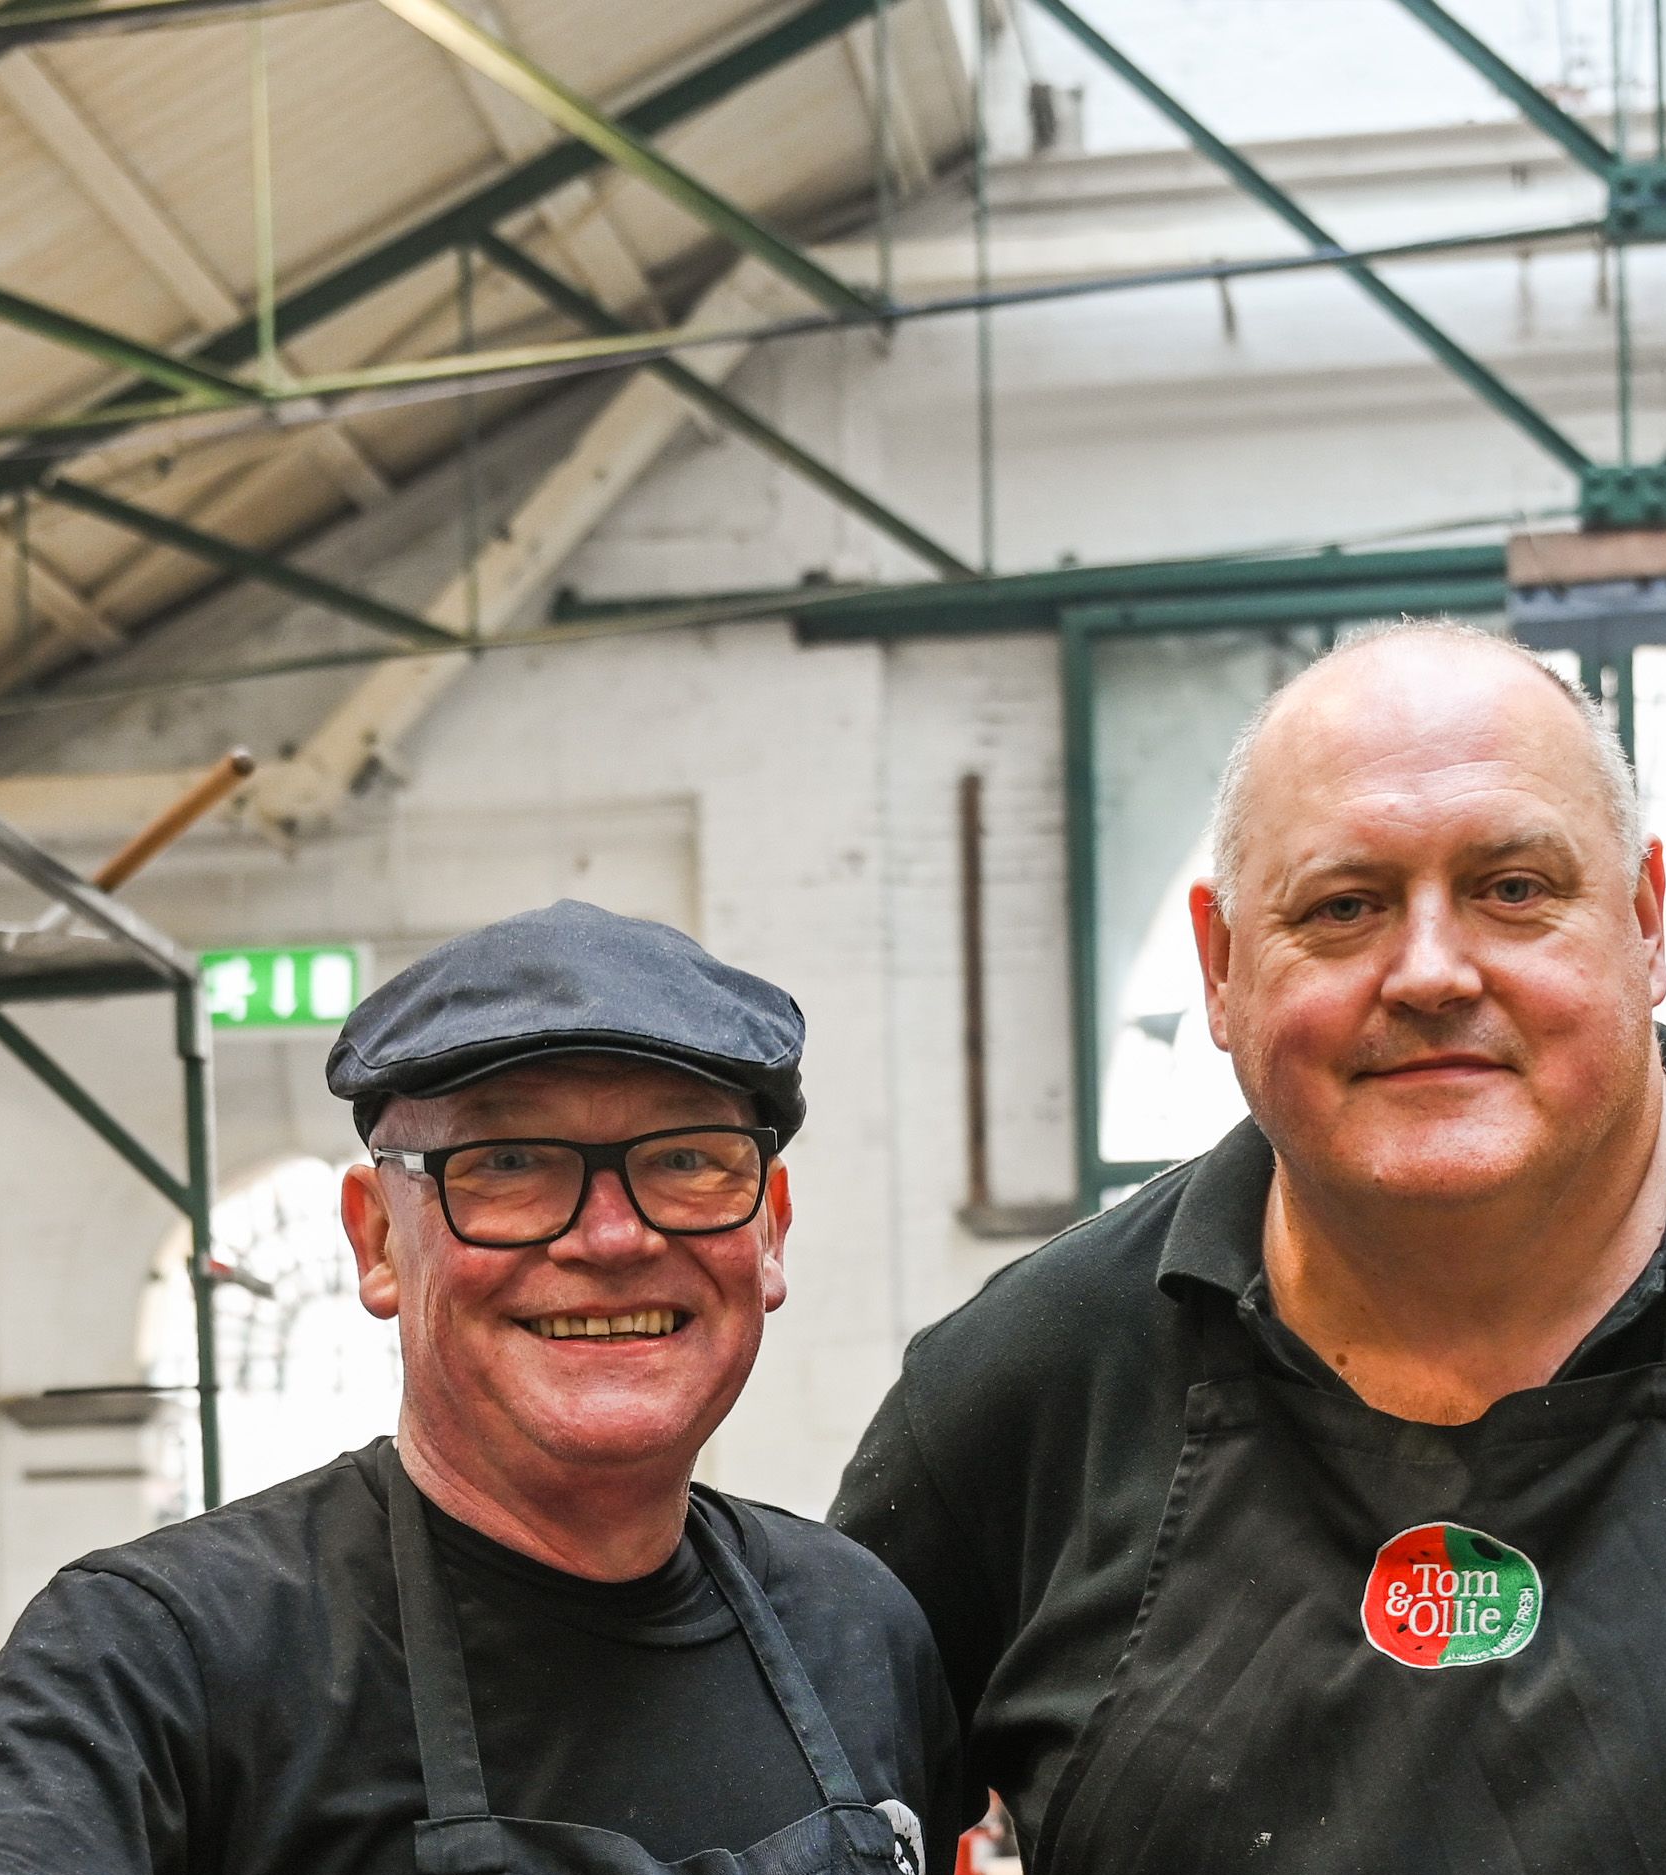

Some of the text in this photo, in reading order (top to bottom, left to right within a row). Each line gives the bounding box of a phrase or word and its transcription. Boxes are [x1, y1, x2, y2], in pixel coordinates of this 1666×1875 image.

[1412, 1563, 1501, 1598] Tom
[1385, 1581, 1502, 1638] & Ollie
[1491, 1620, 1524, 1656] MARKET
[1515, 1587, 1534, 1621] FRESH
